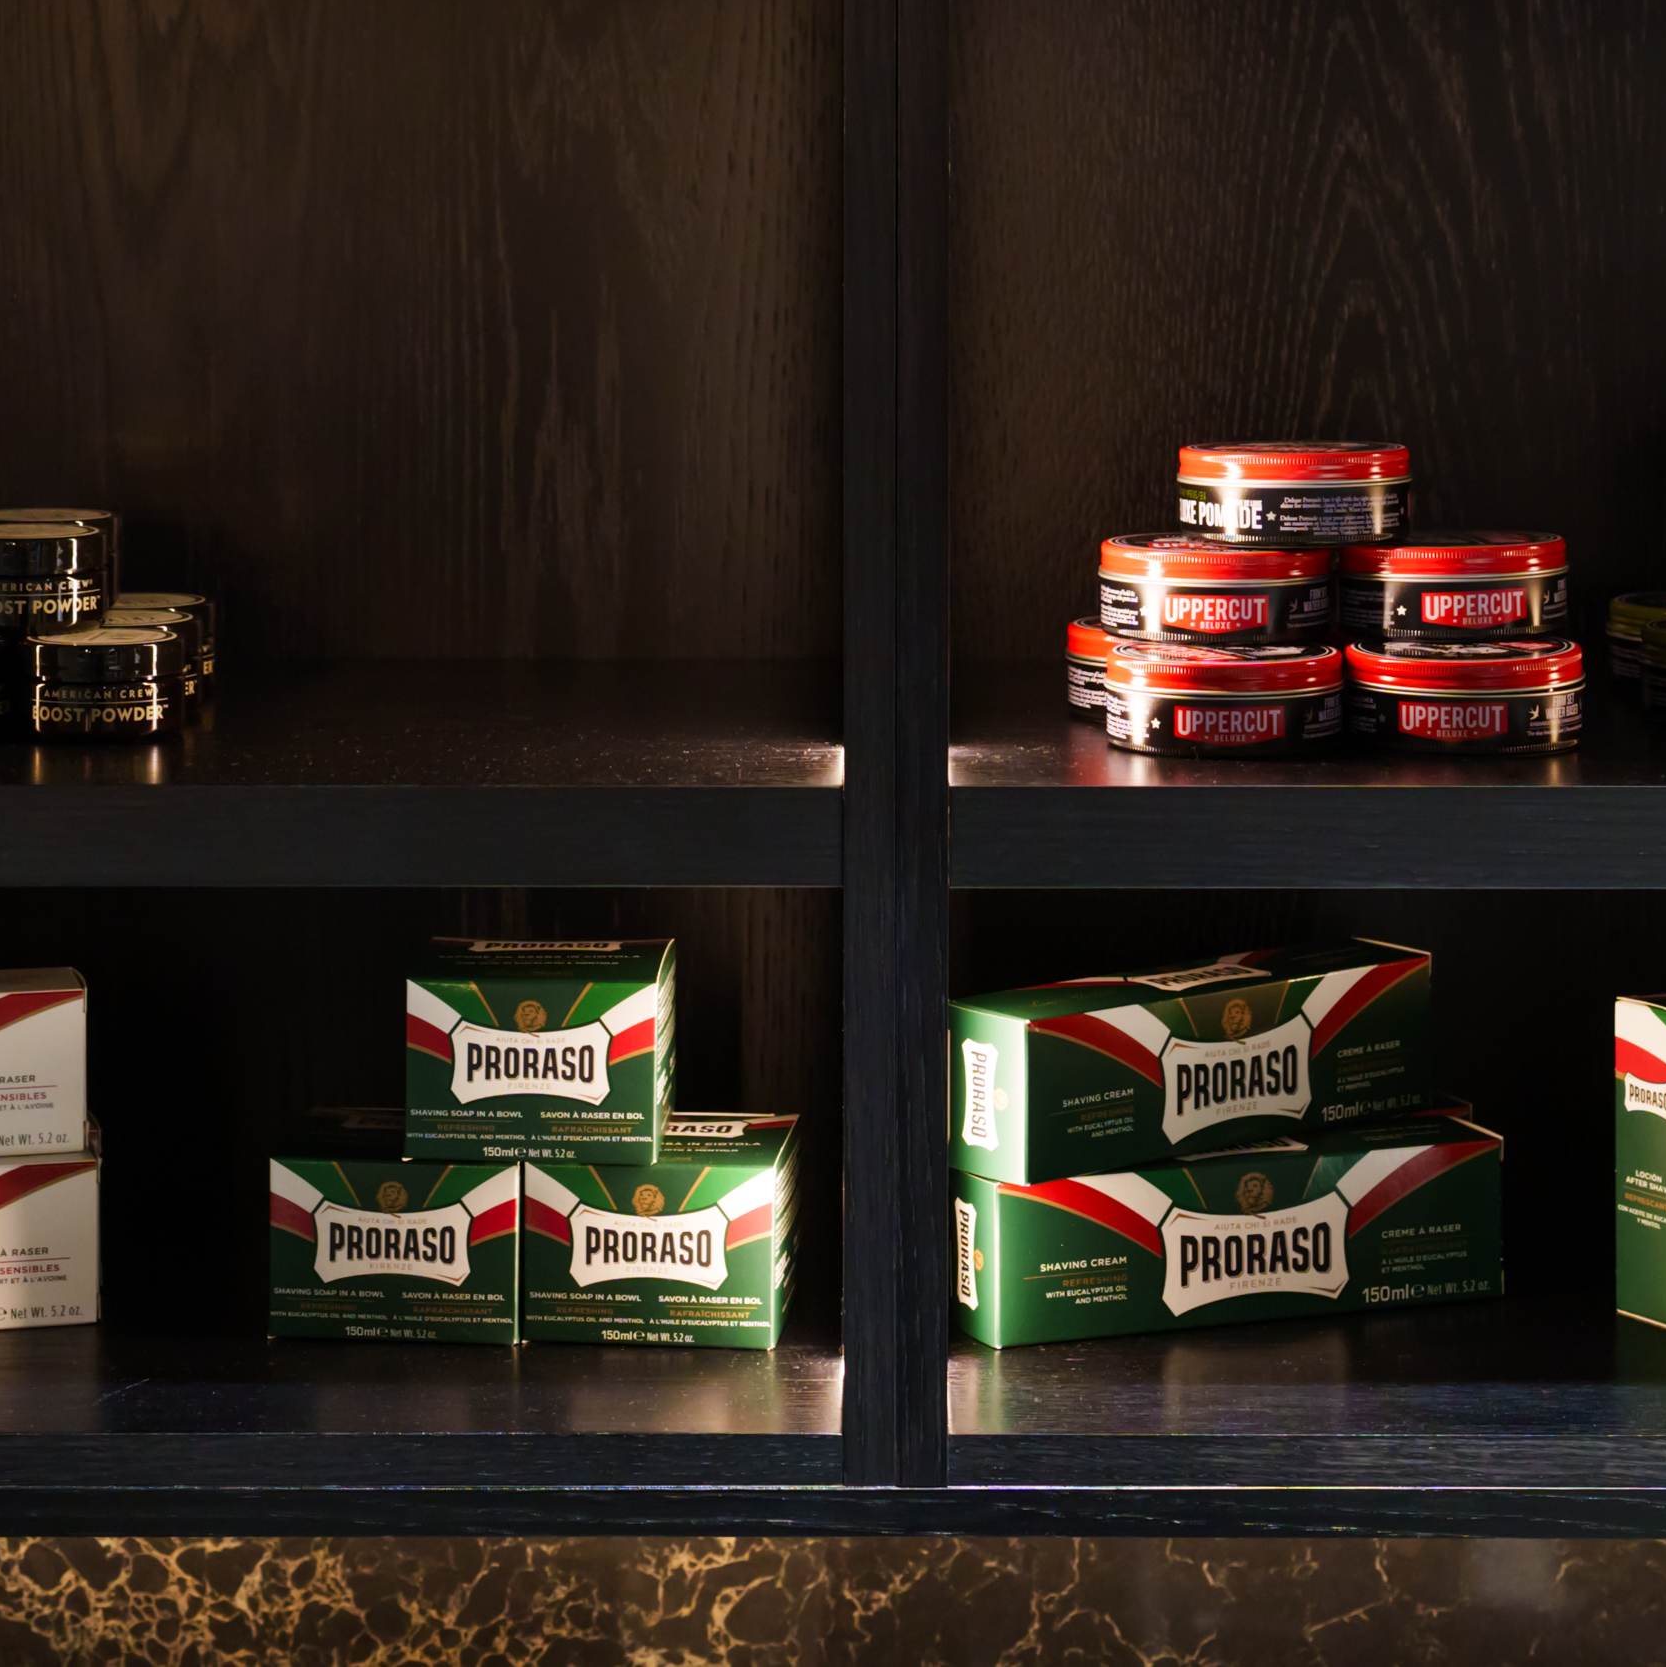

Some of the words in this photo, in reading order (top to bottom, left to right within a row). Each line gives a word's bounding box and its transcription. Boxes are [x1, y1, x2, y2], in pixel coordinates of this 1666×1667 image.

[1165, 597, 1266, 623] UPPERCUT
[1424, 591, 1524, 621] UPPERCUT
[32, 707, 82, 723] BOOST
[1177, 709, 1281, 735] UPPERCUT
[1401, 705, 1504, 731] UPPERCUT
[467, 1042, 594, 1083] PRORASO
[1177, 1044, 1298, 1116] PRORASO
[971, 1050, 987, 1138] PRORASO
[410, 1109, 449, 1117] SHAVING
[477, 1110, 486, 1118] IN
[497, 1111, 523, 1119] BOWL
[540, 1111, 571, 1119] SAVON
[573, 1109, 580, 1119] À
[582, 1112, 611, 1120] RASER
[613, 1112, 625, 1120] EN
[627, 1112, 644, 1120] BOL
[18, 1134, 34, 1146] Wt.
[38, 1133, 52, 1144] 5.2
[56, 1134, 70, 1144] oz.
[1626, 1176, 1648, 1189] AFTER
[1635, 1169, 1662, 1183] LOCIÓN
[329, 1222, 456, 1264] PRORASO
[586, 1226, 712, 1267] PRORASO
[959, 1209, 971, 1298] PRORASO
[1180, 1221, 1331, 1287] PRORASO
[1040, 1259, 1087, 1272] SHAVING
[1091, 1256, 1127, 1267] CREAM
